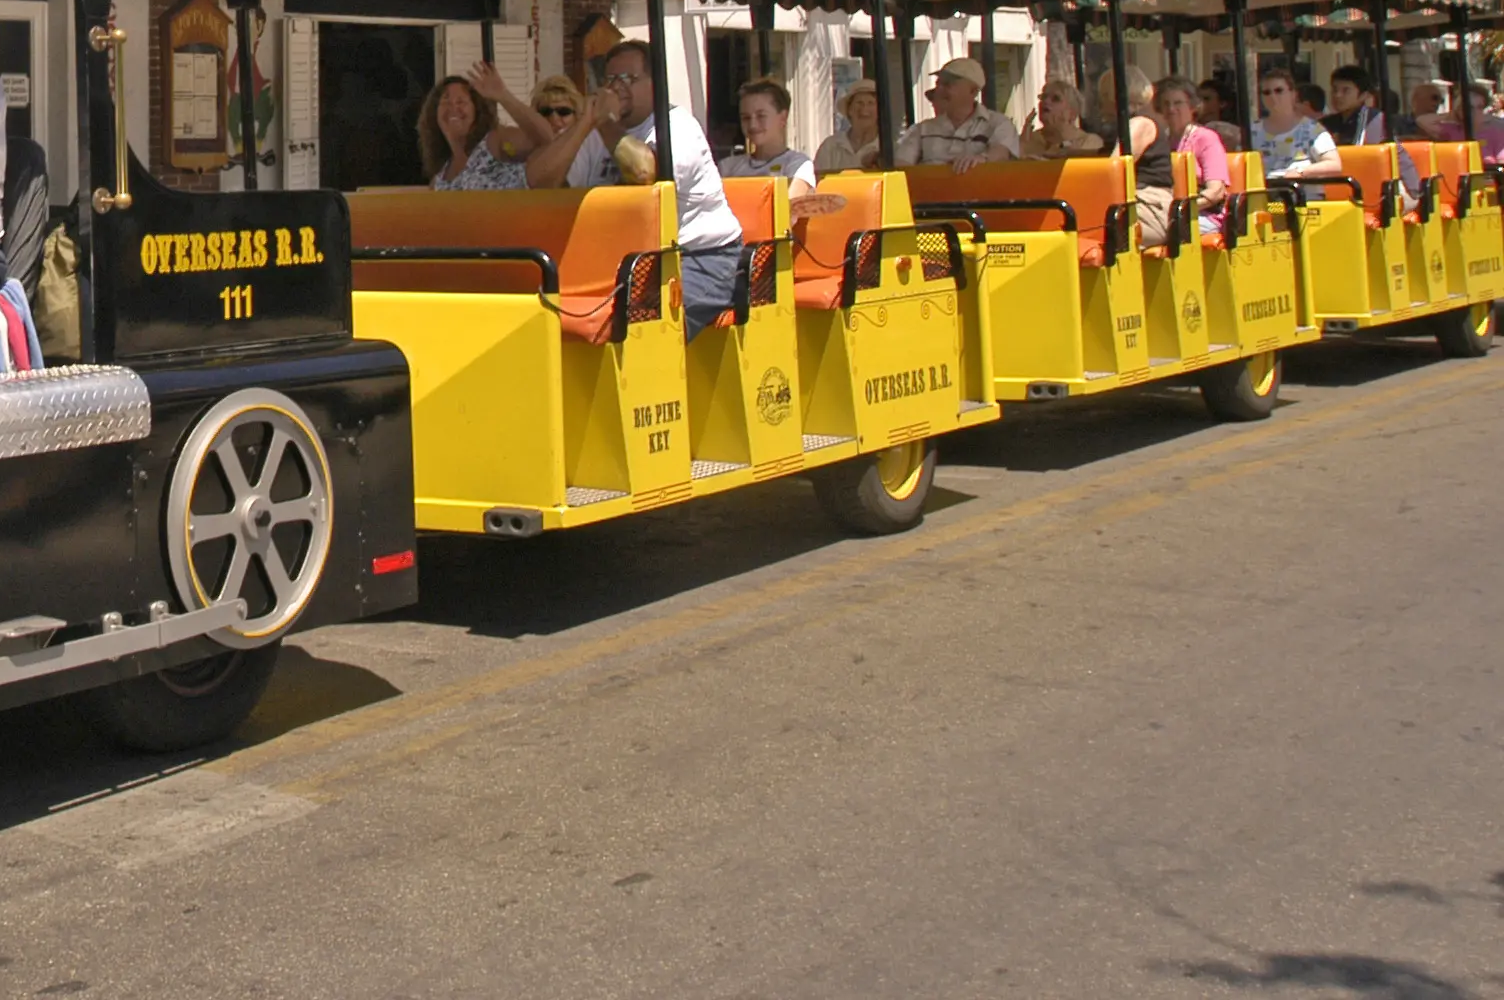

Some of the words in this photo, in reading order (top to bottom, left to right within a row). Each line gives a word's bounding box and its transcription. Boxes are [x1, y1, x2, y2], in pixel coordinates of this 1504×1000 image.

[140, 230, 268, 275] OVERSEAS
[275, 226, 324, 266] R.R.
[219, 284, 253, 320] 111
[864, 370, 926, 406] OVERSEAS
[929, 363, 953, 392] R.R.
[633, 405, 653, 429] BIG
[655, 400, 682, 426] PINE
[648, 429, 671, 455] KEY
